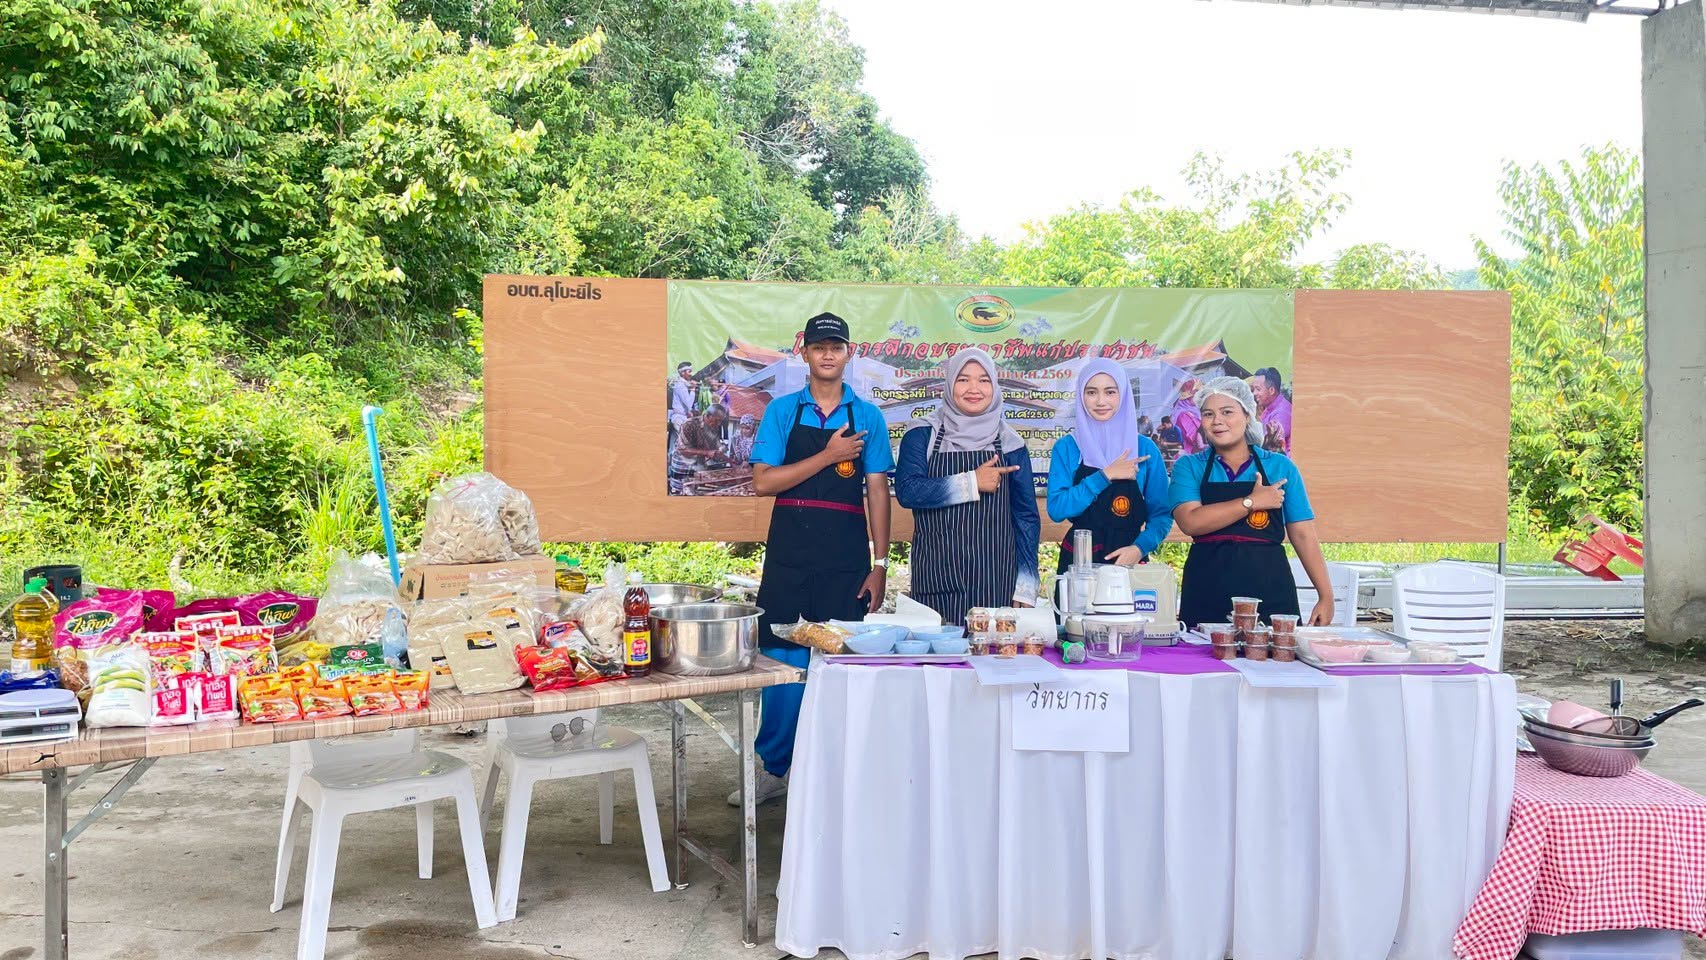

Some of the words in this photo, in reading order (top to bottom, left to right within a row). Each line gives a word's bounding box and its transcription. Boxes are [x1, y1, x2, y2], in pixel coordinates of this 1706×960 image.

[1135, 601, 1155, 610] MARA
[1025, 682, 1110, 711] วิทยากร
